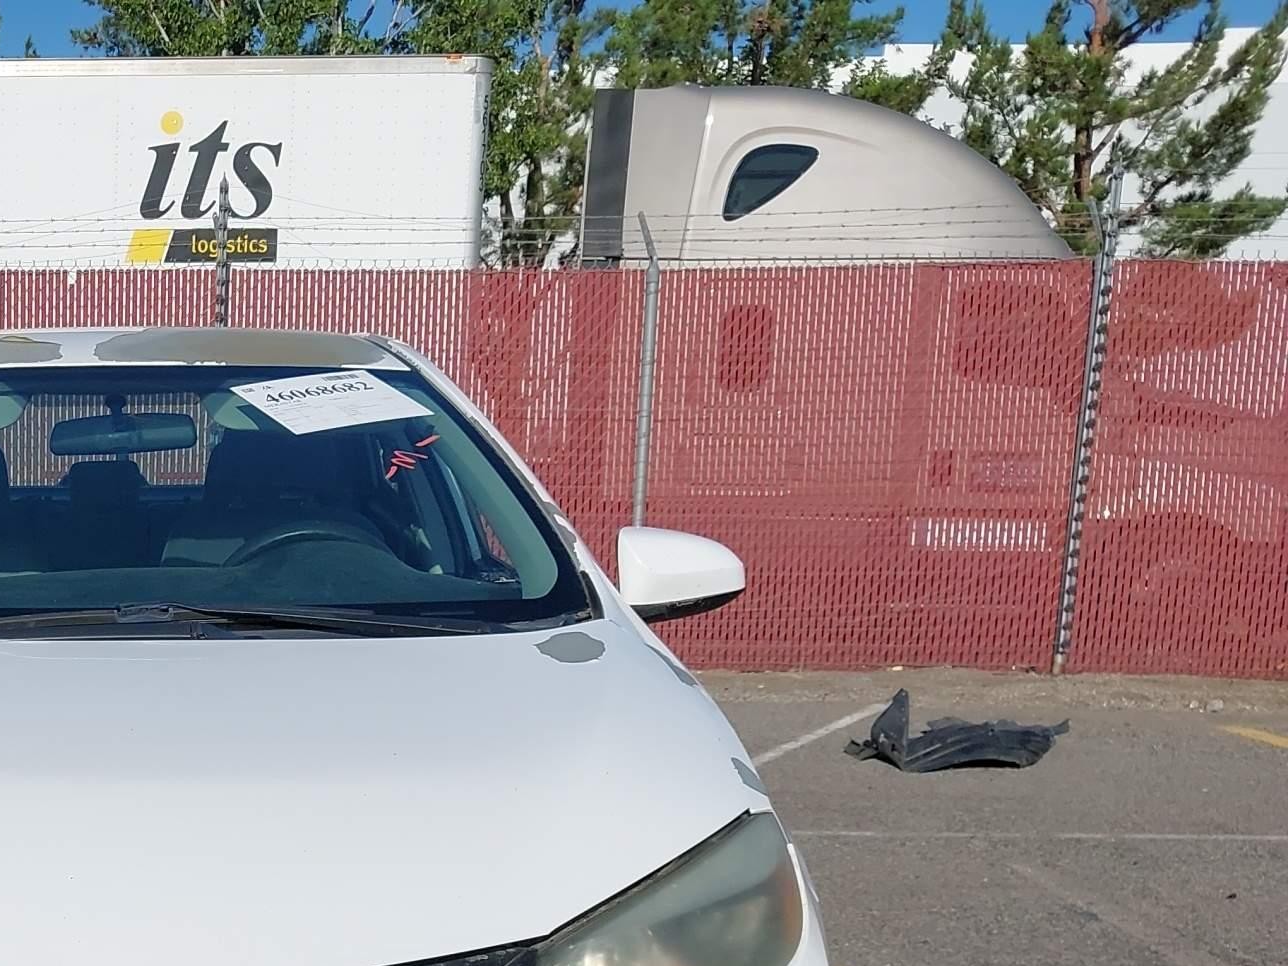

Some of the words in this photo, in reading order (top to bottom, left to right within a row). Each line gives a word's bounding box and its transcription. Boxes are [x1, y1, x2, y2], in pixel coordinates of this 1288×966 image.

[140, 111, 283, 220] its
[191, 234, 268, 257] logstics
[265, 381, 374, 403] 46068682
